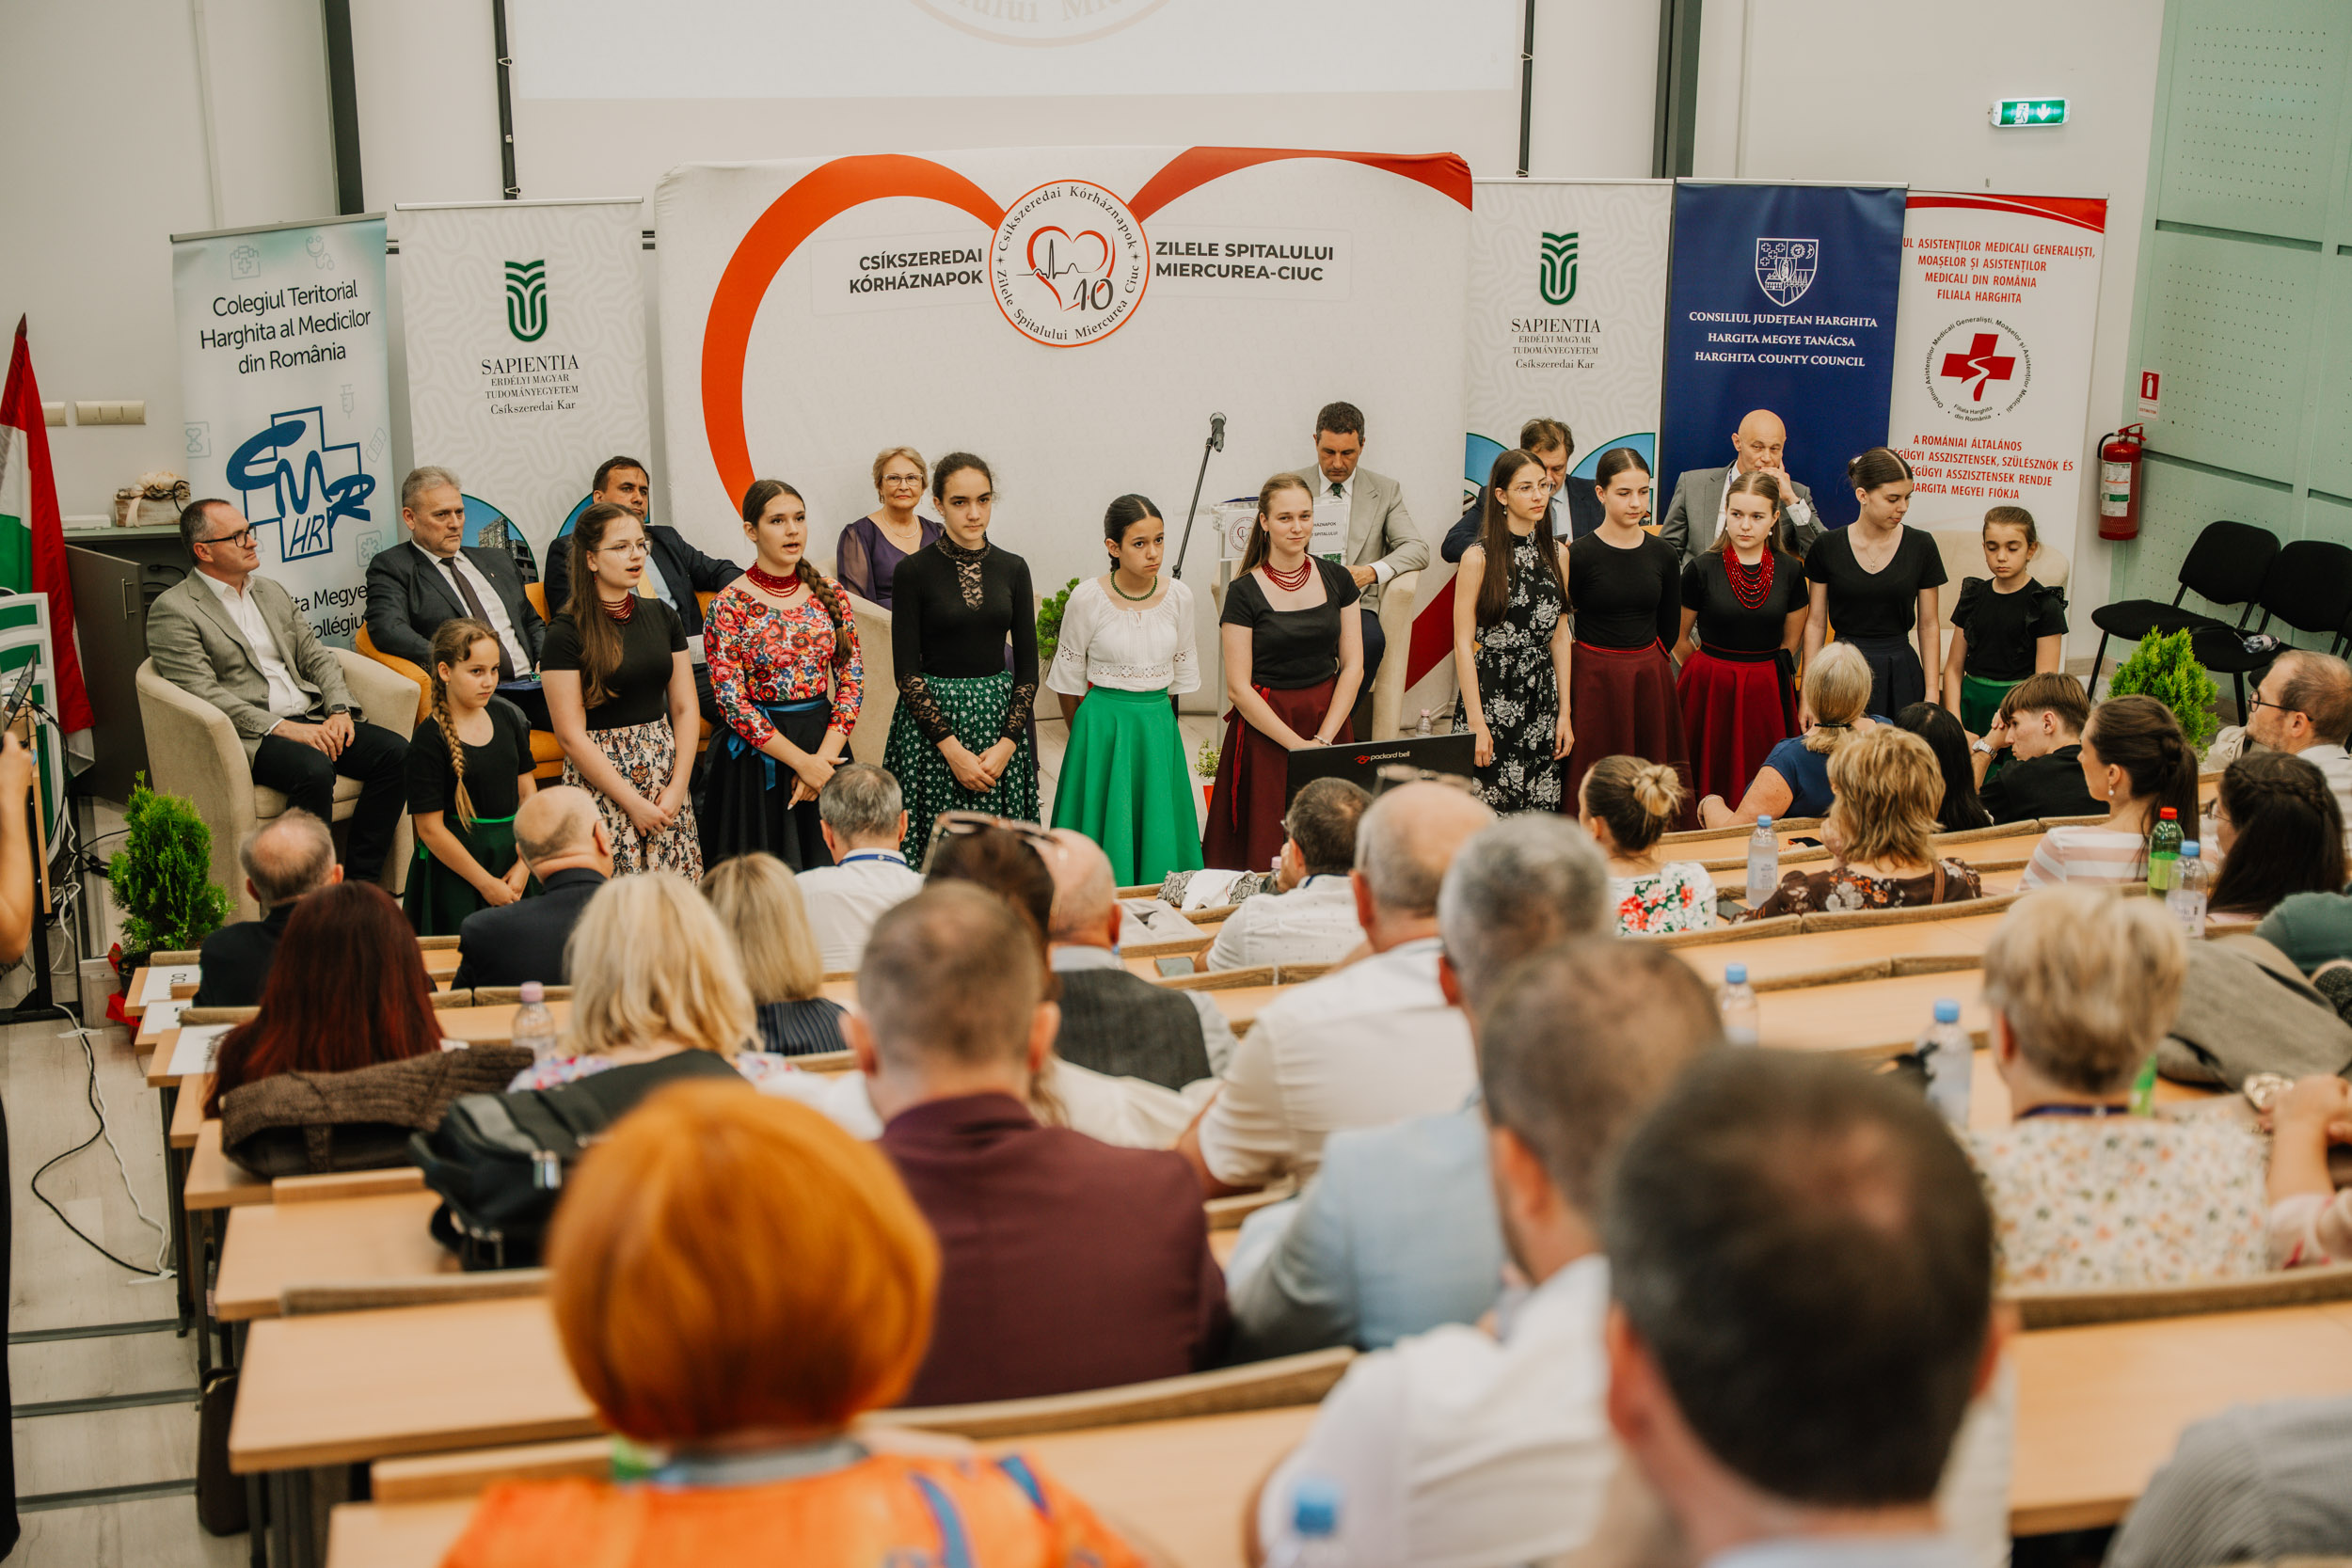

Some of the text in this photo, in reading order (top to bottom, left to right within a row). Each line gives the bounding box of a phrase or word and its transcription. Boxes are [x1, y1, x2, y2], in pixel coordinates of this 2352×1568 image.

[998, 185, 1137, 251] Csíkszeredai Kórháznapok
[1155, 241, 1333, 261] ZILELE SPITALULUI
[1985, 242, 2029, 254] MEDICALI
[859, 247, 983, 271] CSÍKSZEREDAI
[1155, 263, 1324, 281] MIERCUREA-CIUC
[1925, 272, 2037, 288] MEDICALI DIN ROMÂNIA
[849, 269, 984, 293] KÓRHÁZNAPOK
[213, 279, 358, 317] Colegiul Teritorial
[1073, 278, 1114, 310] 10
[1937, 289, 2022, 304] FILIALA HARGHITA
[997, 265, 1139, 341] Zilele Spitalului Miercurea Ciuc
[1511, 318, 1601, 333] SAPIENTIA
[1689, 311, 1751, 324] CONSILIUL
[1815, 316, 1878, 327] HARGHITA
[200, 309, 371, 349] Harghita al Medicilor
[1931, 324, 1956, 345] Medicali
[1518, 334, 1554, 343] ERDÉLYI
[1708, 332, 1855, 347] HARGITA MEGYE TANÁCSA
[238, 342, 346, 374] din România
[1513, 345, 1598, 355] TUDOMÁNYEGYETEM
[481, 354, 580, 375] SAPIENTIA
[1516, 359, 1595, 369] Csíkszeredai Kar
[1694, 352, 1866, 367] HARGHITA COUNTY COUNCIL
[491, 373, 569, 387] ERDÉLYI MAGYAR
[485, 385, 579, 399] TUDOMÁNYEGYETEM
[1927, 386, 1944, 408] Ordinul
[490, 400, 576, 415] Csíkszeredai Kar
[1954, 404, 1994, 415] Filiala Harghita
[2006, 389, 2027, 413] Medicali
[1913, 435, 2023, 451] A ROMÁNIAI ÁLTALÁNOS
[1893, 448, 1925, 461] GÜGYI
[1929, 451, 1999, 467] ASSZISZTENSEK,
[2063, 458, 2074, 471] ÉS
[1946, 468, 2014, 483] ASSZISZTENSEK
[2019, 474, 2053, 486] RENDJE
[1950, 485, 1984, 497] MEGYEI
[1988, 486, 2020, 499] FIÓKJA
[314, 585, 367, 609] Megye
[1370, 752, 1397, 762] packard
